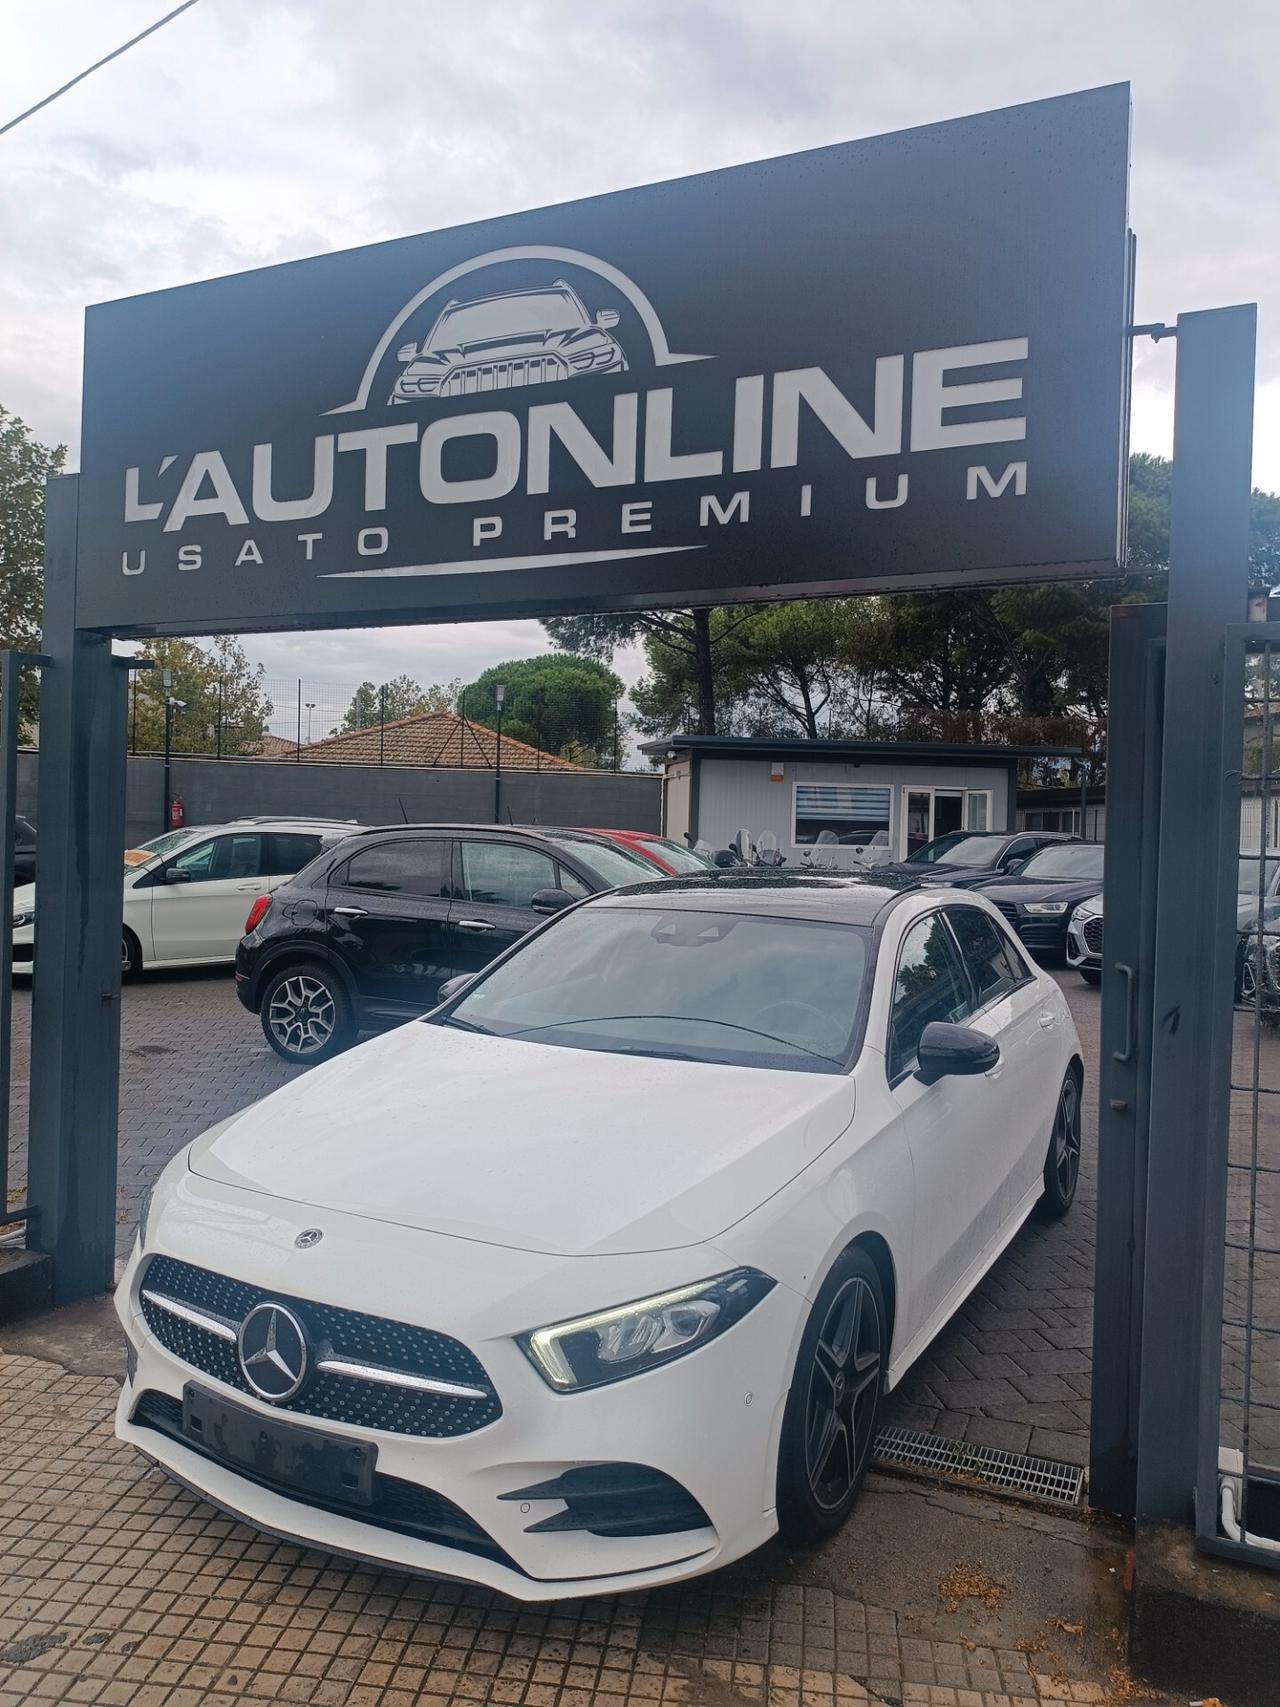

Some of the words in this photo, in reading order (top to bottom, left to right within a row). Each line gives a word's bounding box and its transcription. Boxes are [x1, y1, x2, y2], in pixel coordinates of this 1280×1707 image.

[123, 337, 1029, 532] L'AUTONLINE
[121, 527, 389, 576] USATO
[472, 461, 1028, 547] PREMIUM
